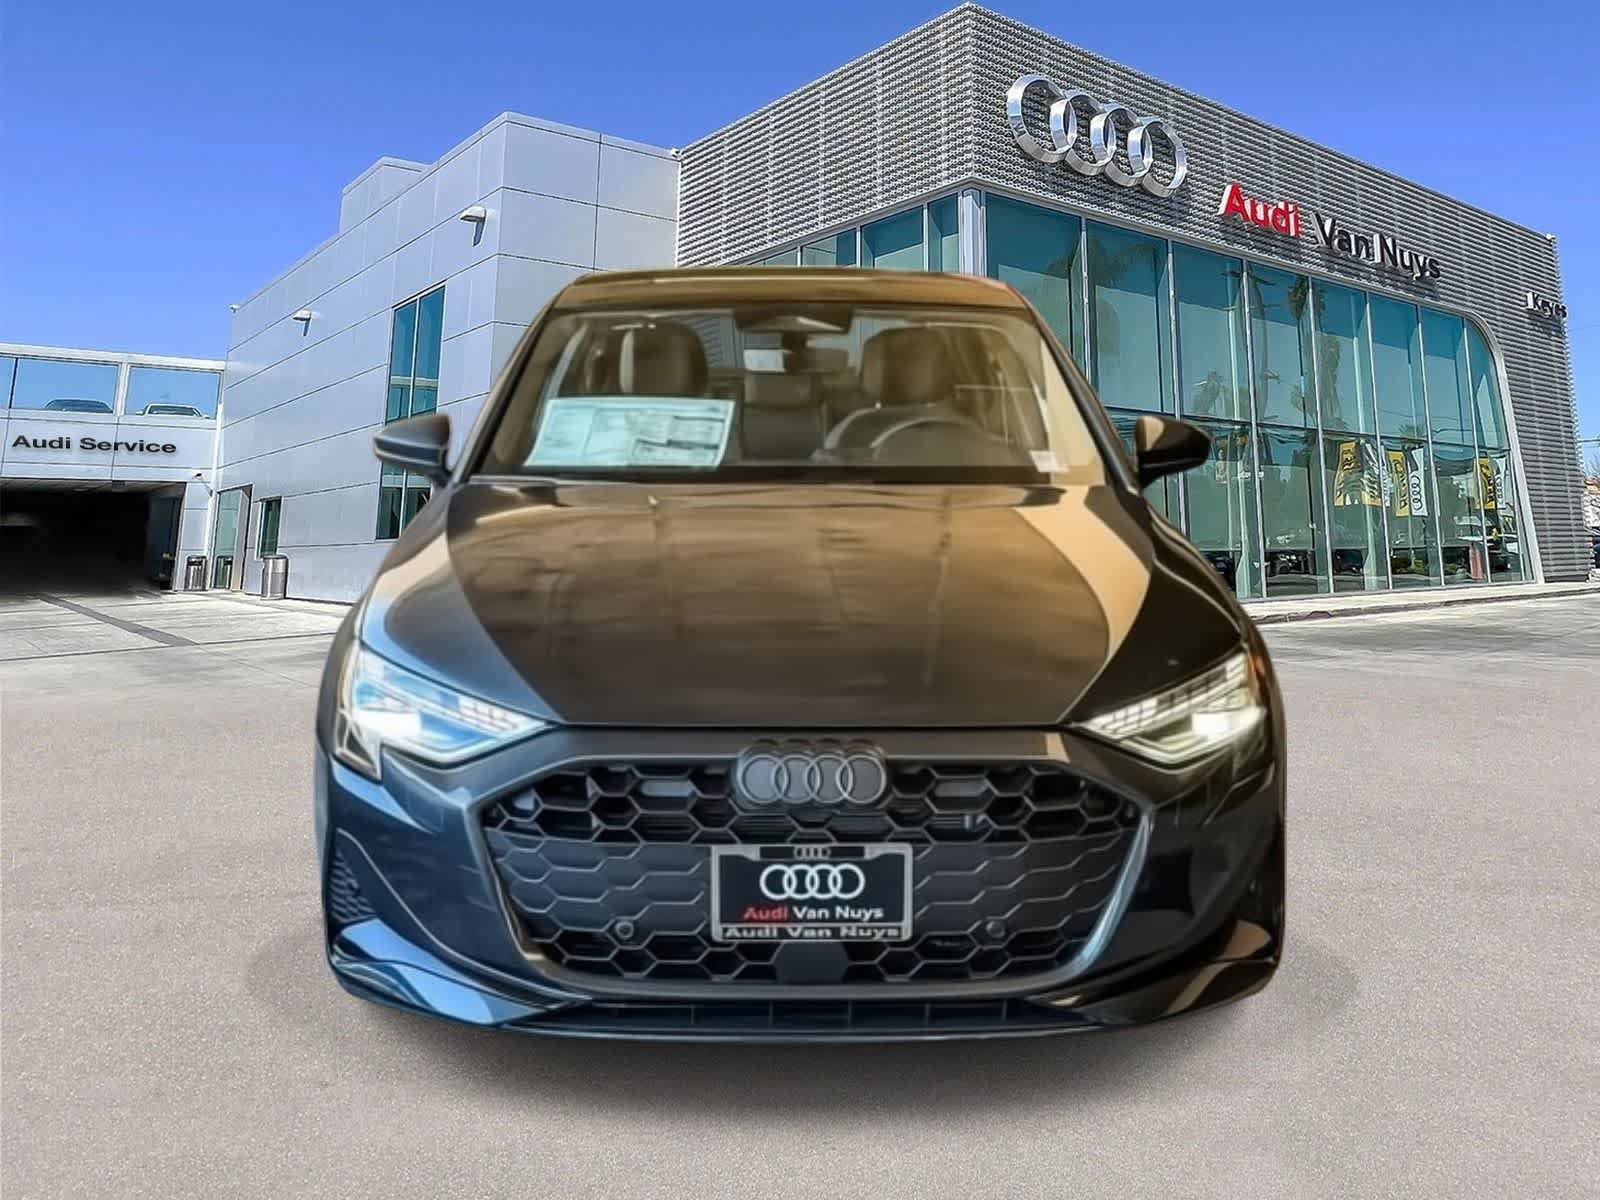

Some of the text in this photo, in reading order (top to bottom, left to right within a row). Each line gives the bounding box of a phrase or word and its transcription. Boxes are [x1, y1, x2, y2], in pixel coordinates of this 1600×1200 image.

[1218, 183, 1442, 281] Audi Van Nuys
[12, 434, 178, 454] Audi Service
[743, 905, 884, 921] Audi Van Nuys
[724, 926, 900, 940] Audi Van Nuys
